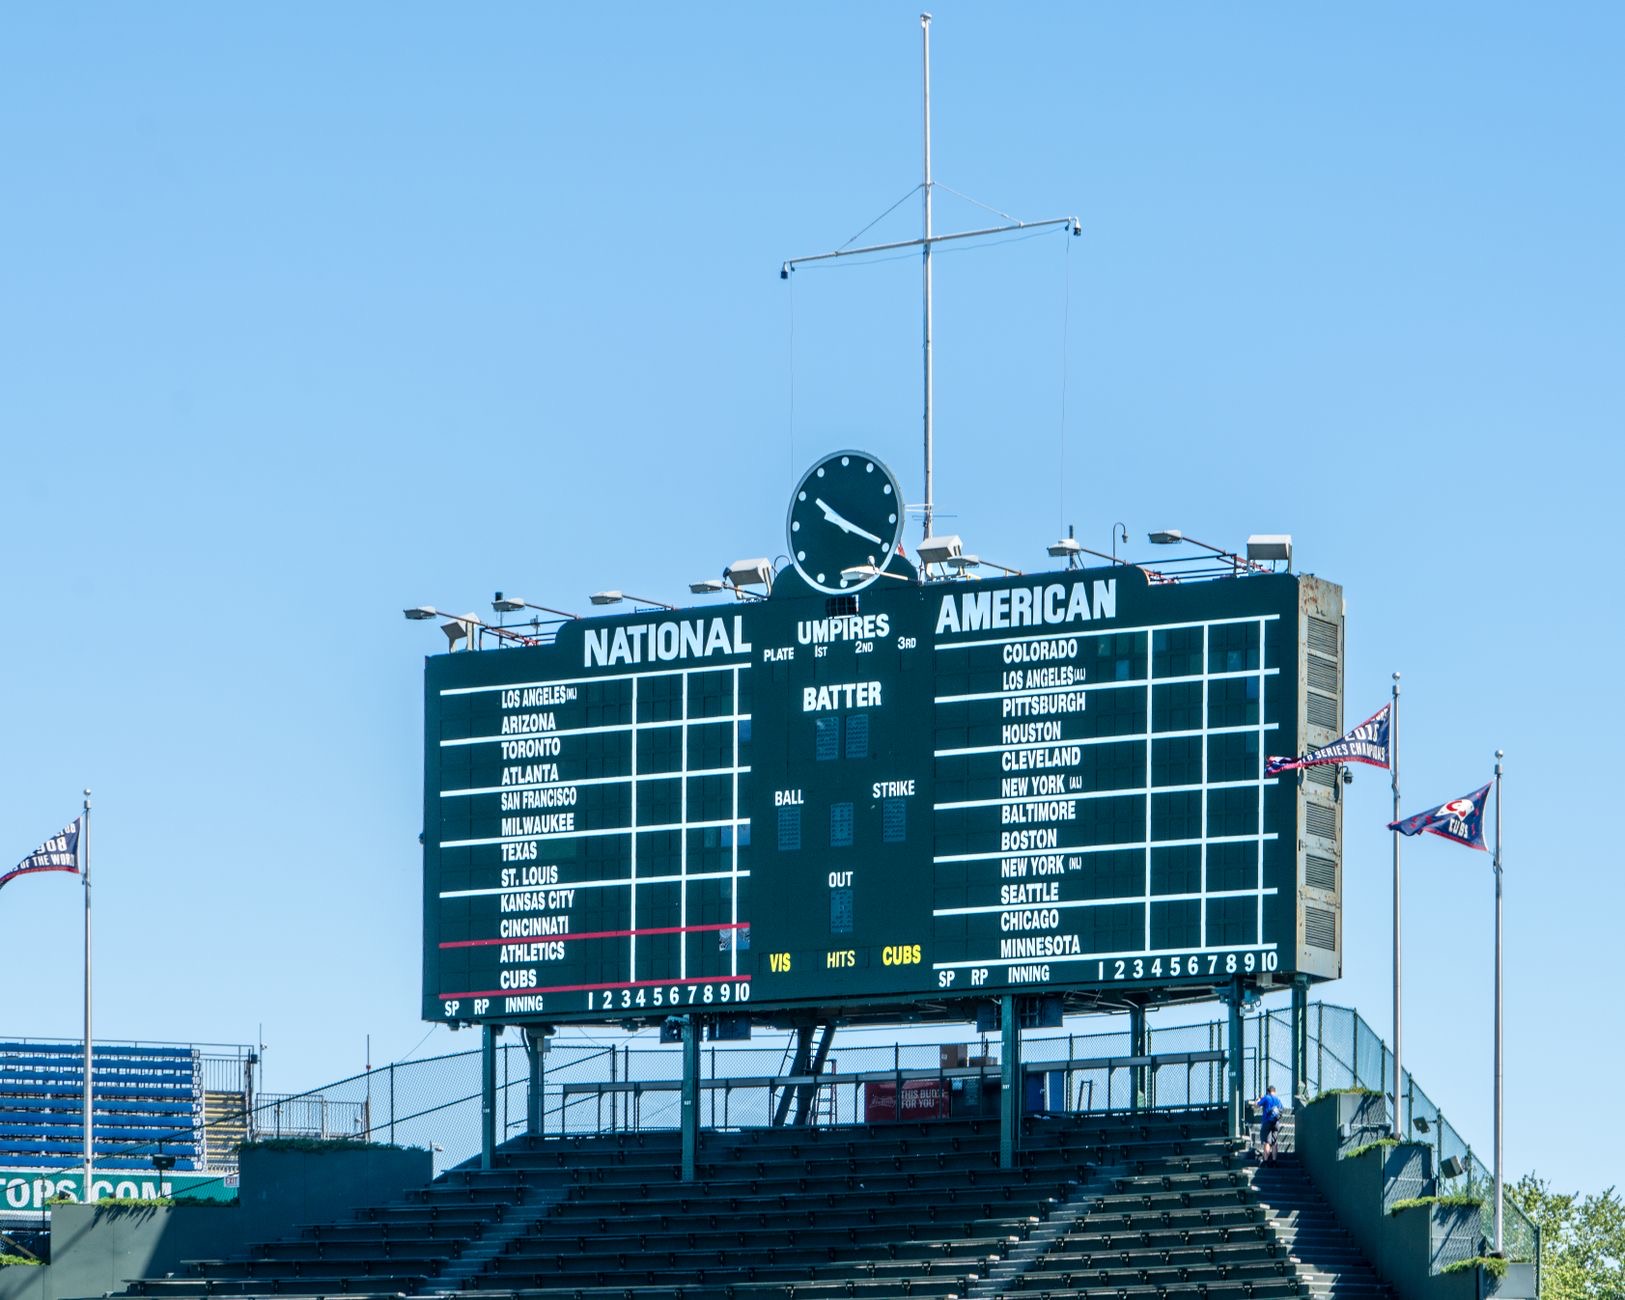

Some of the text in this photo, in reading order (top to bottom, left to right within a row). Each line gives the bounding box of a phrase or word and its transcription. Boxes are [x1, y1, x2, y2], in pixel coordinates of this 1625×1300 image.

[935, 579, 1116, 634] AMERICAN
[797, 613, 890, 645] UMPIRES
[584, 615, 751, 667] NATIONAL
[763, 647, 795, 662] PLATE
[855, 641, 874, 654] 2ND
[897, 636, 917, 650] 3RD
[1003, 638, 1077, 664] COLORADO
[1003, 670, 1023, 691] LOS
[1026, 666, 1073, 688] ANGELES
[502, 690, 520, 709] LOS
[522, 686, 566, 707] ANGELES
[802, 681, 882, 712] BATTER
[1002, 692, 1086, 717] PITTSBURGH
[501, 713, 556, 734] ARIZONA
[1002, 721, 1061, 744] HOUSTON
[501, 738, 560, 760] TORONTO
[1002, 747, 1081, 771] CLEVELAND
[1315, 743, 1348, 760] SERIES
[501, 763, 559, 785] ATLANTA
[774, 789, 804, 806] BALL
[872, 780, 915, 798] STRIKE
[1002, 775, 1082, 798] NEW YORK (AL)
[501, 787, 576, 811] SAN FRANCISCO
[1002, 800, 1075, 824] BALTIMORE
[501, 813, 575, 836] MILWAUKEE
[501, 841, 537, 861] TEXAS
[1001, 829, 1057, 851] BOSTON
[32, 855, 50, 867] THE
[1001, 855, 1082, 878] NEW YORK (NL)
[501, 866, 558, 888] ST. LOUIS
[828, 871, 853, 888] OUT
[501, 889, 575, 912] KANSAS CITY
[1001, 882, 1059, 904] SEATTLE
[500, 916, 568, 938] CINCINNATI
[1001, 909, 1059, 932] CHICAGO
[500, 941, 565, 964] ATHLETICS
[769, 944, 922, 972] VIS HITS CUBS
[1001, 935, 1081, 958] MINNESOTA
[501, 969, 537, 989] CUBS
[939, 951, 1278, 988] SP RP INNING 1 2 3 4 5 6 7 8 9 10
[445, 982, 750, 1017] SP RP INNING 1 2 3 4 5 6 7 8 9 10
[901, 1089, 919, 1100] THIS
[901, 1100, 916, 1109] FOR
[919, 1099, 935, 1108] YOU
[225, 1177, 238, 1186] EXIT
